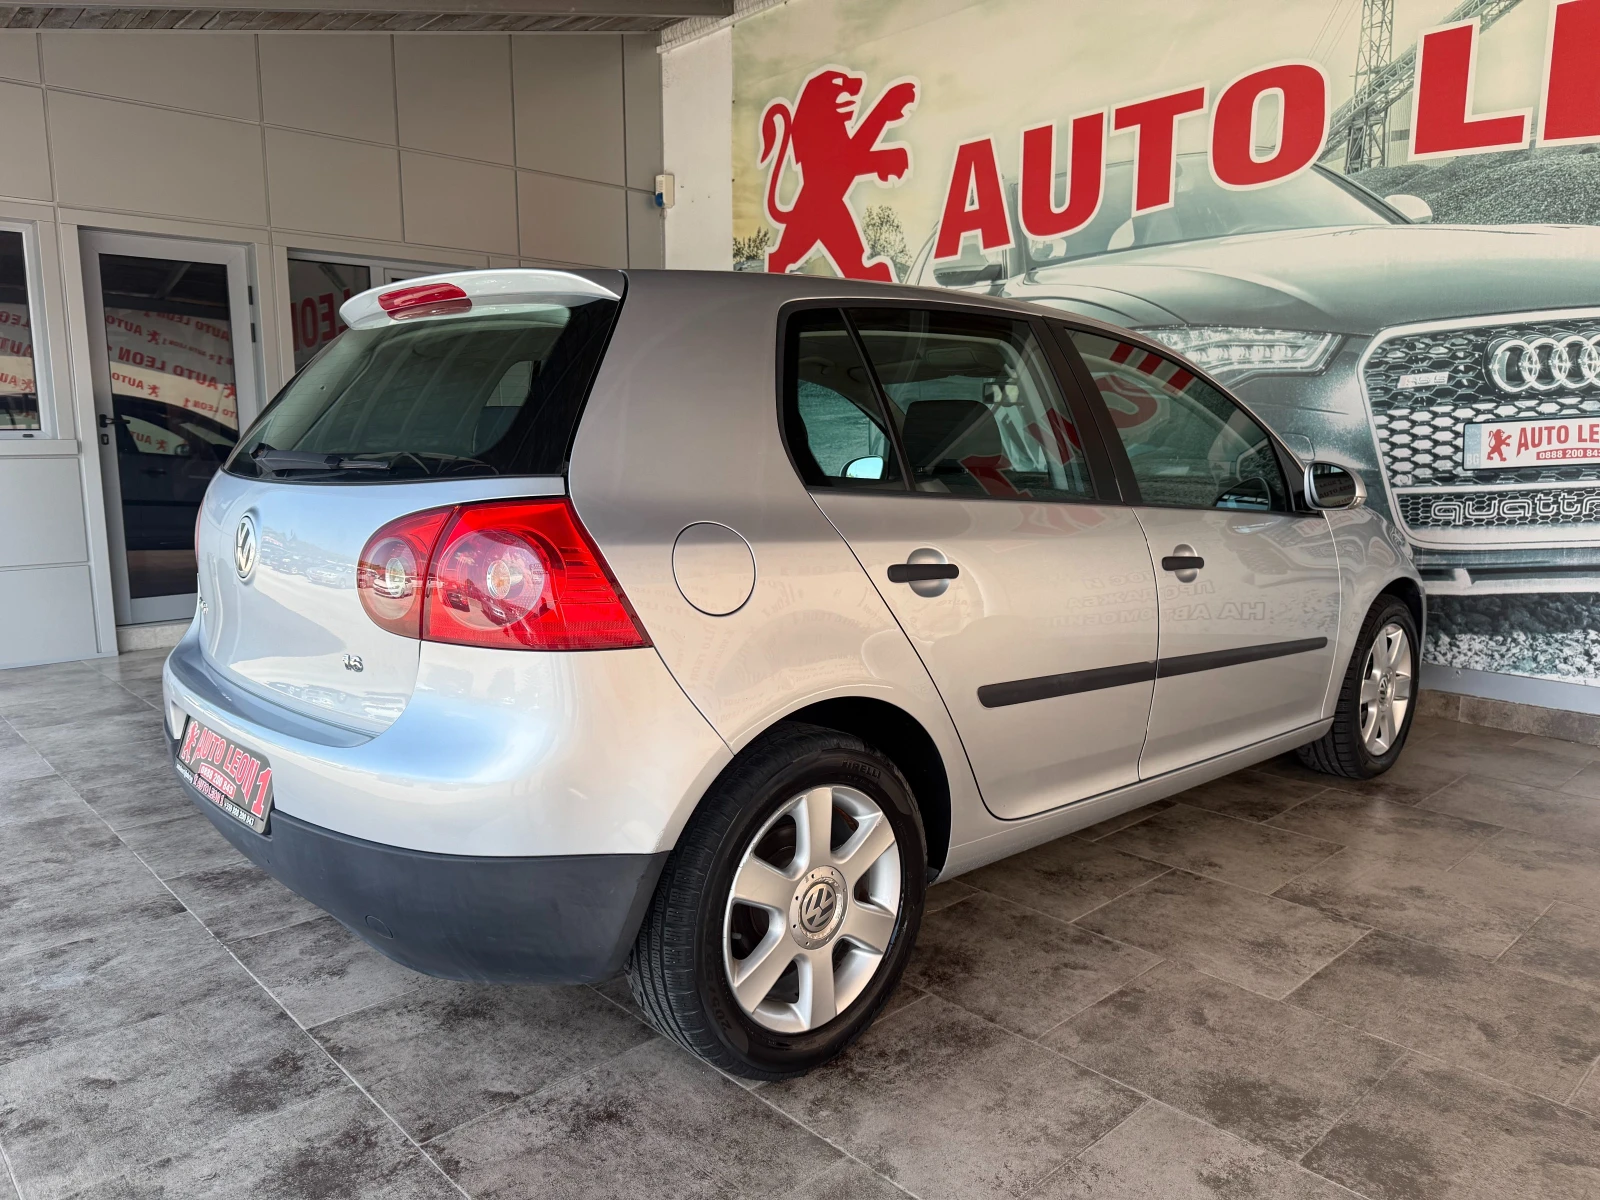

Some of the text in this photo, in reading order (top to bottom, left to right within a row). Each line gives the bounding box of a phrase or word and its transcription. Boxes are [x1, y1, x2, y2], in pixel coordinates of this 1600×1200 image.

[931, 62, 1327, 261] AUTO
[1466, 453, 1480, 463] BG
[1516, 424, 1600, 458] AUTO LE
[1539, 450, 1563, 459] 0888
[1565, 449, 1584, 458] 200
[1431, 492, 1600, 526] quattr
[190, 728, 226, 765] AUTO
[223, 744, 261, 804] LEON
[251, 767, 271, 817] 1
[213, 773, 223, 787] 200
[222, 781, 234, 795] 843
